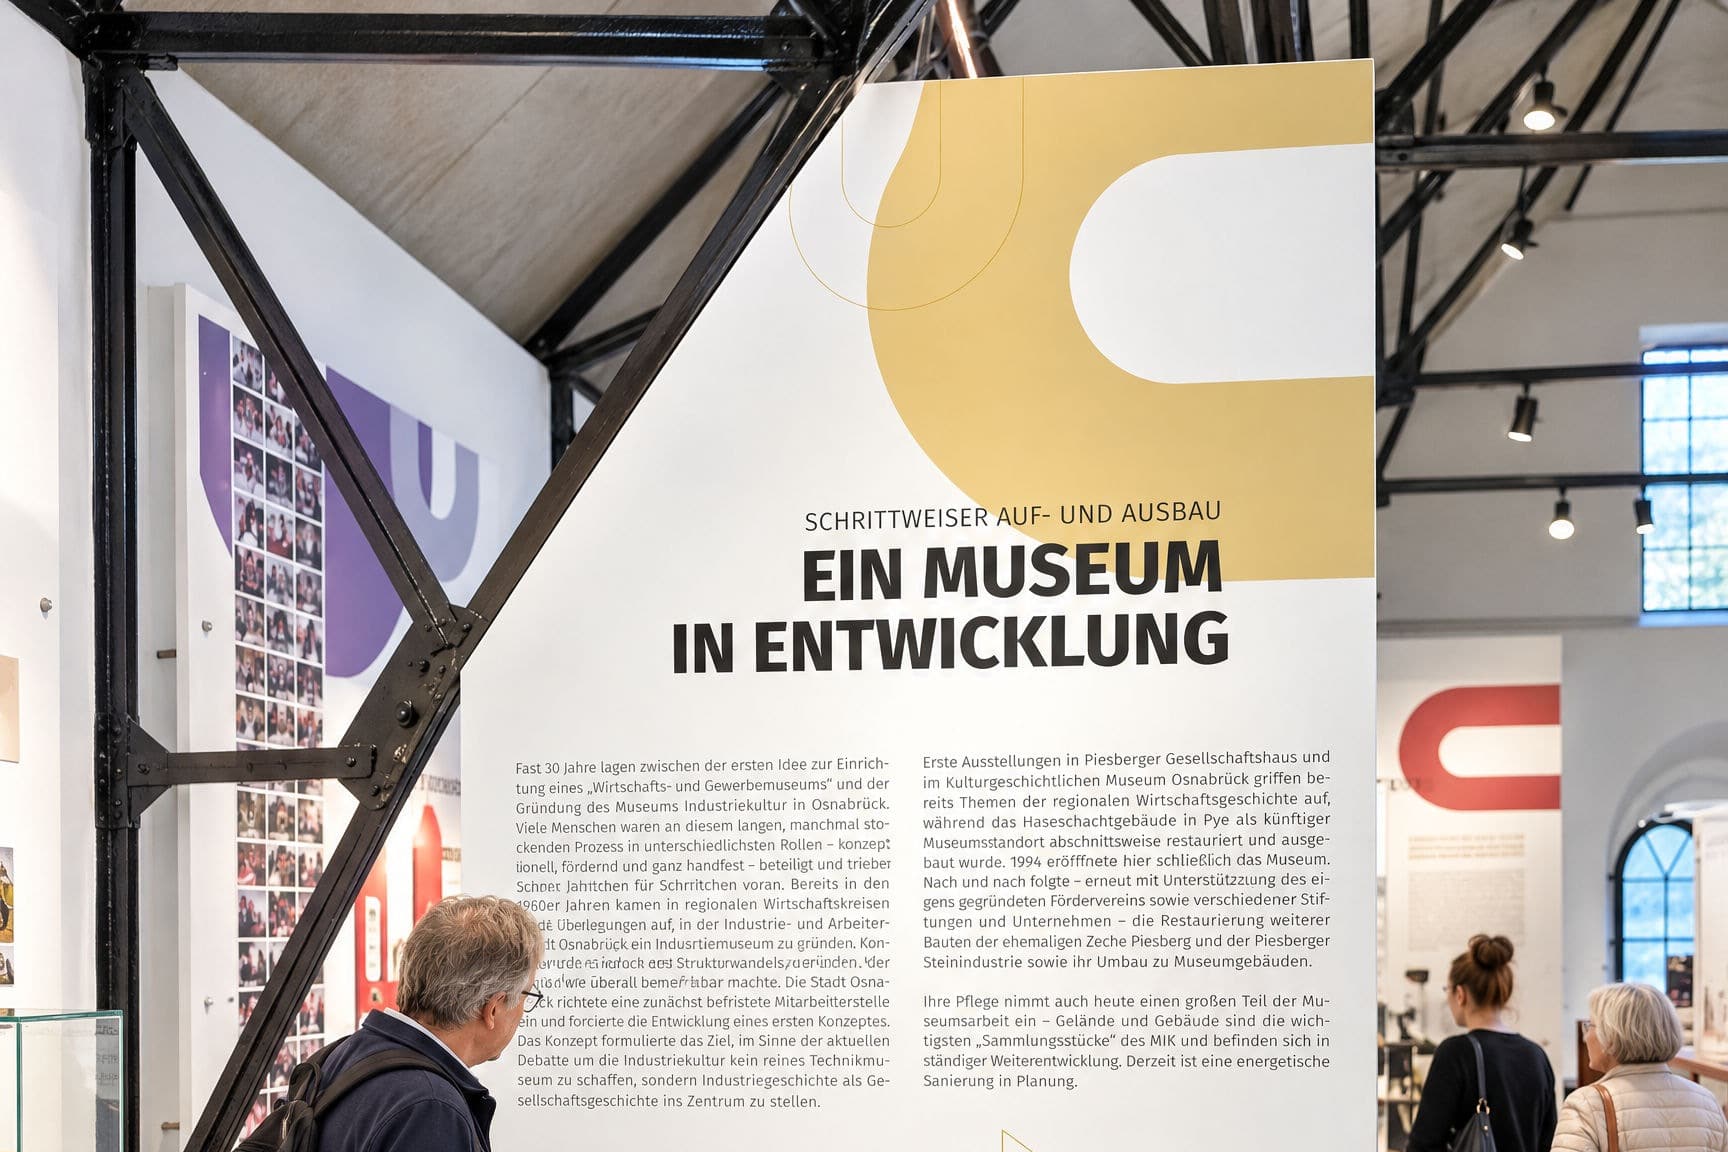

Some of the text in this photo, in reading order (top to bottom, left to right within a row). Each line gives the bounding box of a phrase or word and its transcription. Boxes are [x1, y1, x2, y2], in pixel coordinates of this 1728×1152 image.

[805, 500, 1221, 531] SCHRITTWEISER AUF- UND AUSBAU
[803, 539, 1222, 601] EIN MUSEUM
[673, 610, 1229, 673] IN ENTWICKLUNG
[516, 757, 888, 776] Fast 30 Jahre lagen zwischen der ersten Idee zur Einrich-
[923, 750, 1329, 770] Erste Ausstellungen in Piesberger Gesellschaftshaus und
[515, 777, 889, 797] tung eines „Wirtschafts- und Gewerbemuseums“ und der
[923, 771, 1330, 791] im Kulturgeschichtlichen Museum Osnabrück griffen be-
[515, 797, 889, 816] Gründung des Museums Industriekultur in Osnabrück.
[922, 812, 1330, 830] während das Haseschachtgebäude in Pye als künftiger
[923, 833, 1330, 849] Museumsstandort abschnittsweise restauriert und ausge-
[923, 934, 1330, 950] Bauten der ehemaligen Zeche Piesberg und der Piesberger
[923, 954, 1312, 970] Steinindustrie sowie ihr Umbau zu Museumgebäuden.
[923, 994, 1329, 1010] Ihre Pflege nimmt auch heute einen großen Teil der Mu-
[517, 1034, 889, 1049] Das Konzept formulierte das Ziel, im Sinne der aktuellen
[517, 1073, 890, 1089] seum zu schaffen, sondern Industriegeschichte als Ge-
[923, 1074, 1077, 1090] Sanierung in Planung.
[517, 1094, 820, 1109] sellschaftsgeschichte ins Zentrum zu stellen.
